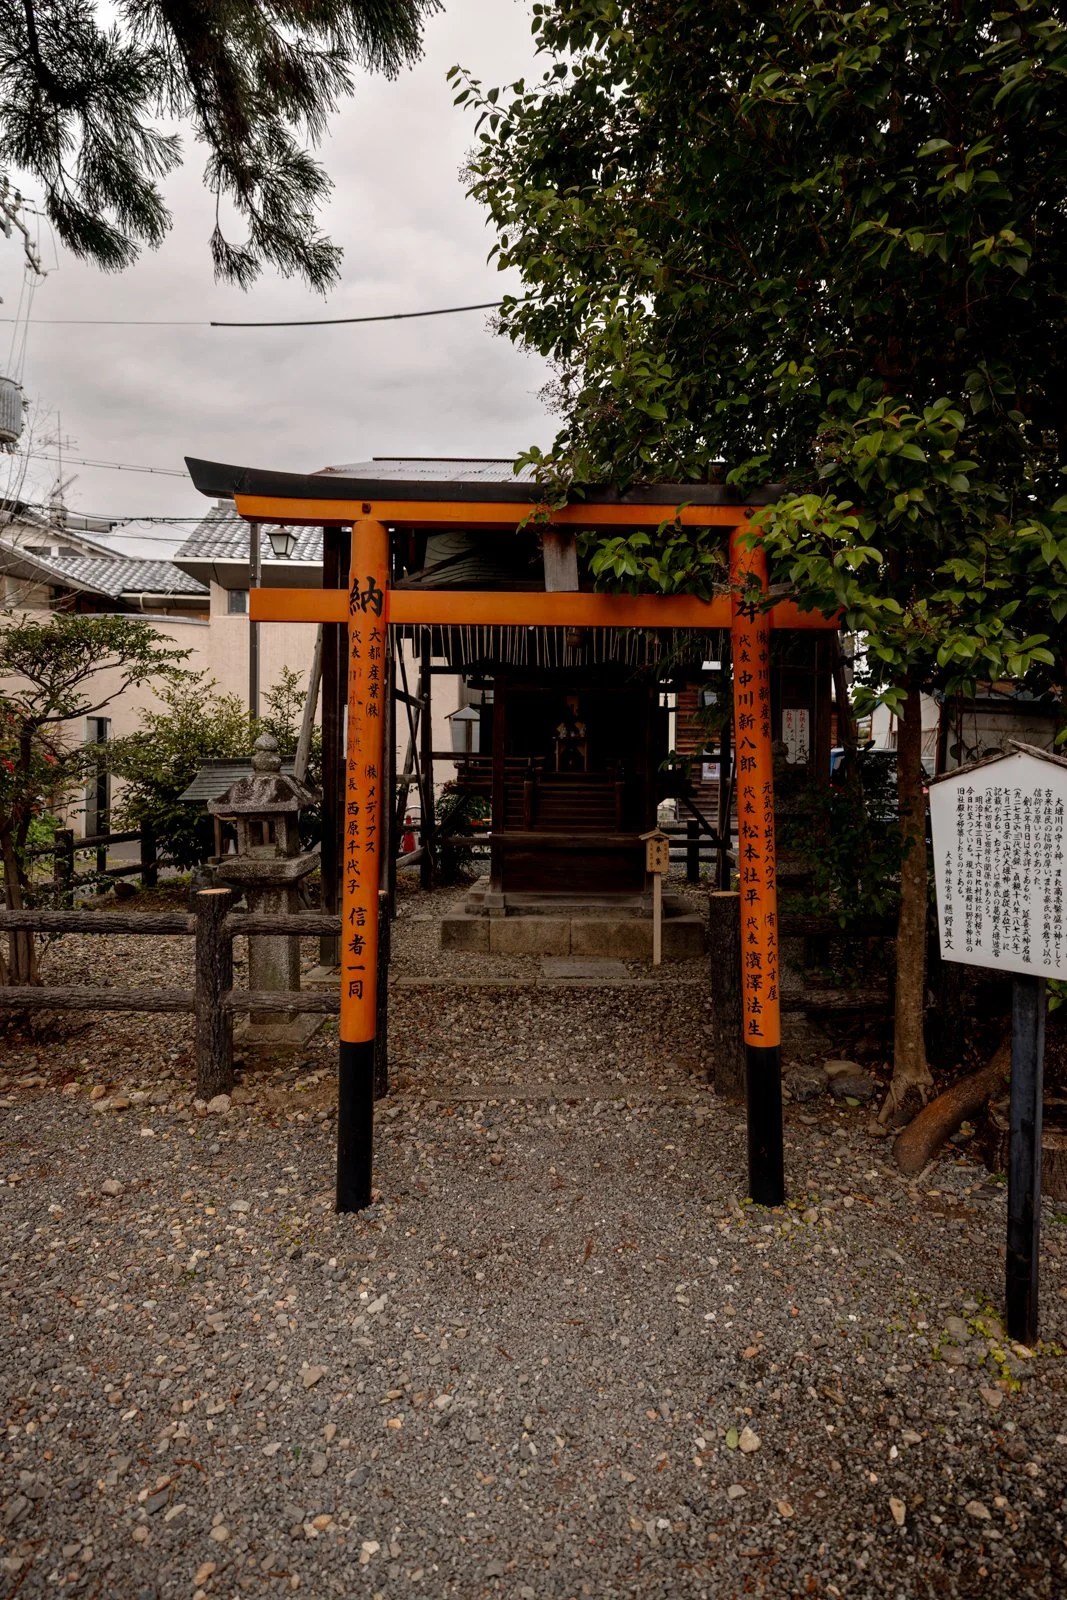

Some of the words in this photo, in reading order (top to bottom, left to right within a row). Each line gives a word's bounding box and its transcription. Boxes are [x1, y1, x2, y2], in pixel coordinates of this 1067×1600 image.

[349, 575, 384, 618] 納
[346, 906, 368, 1000] 信者一同
